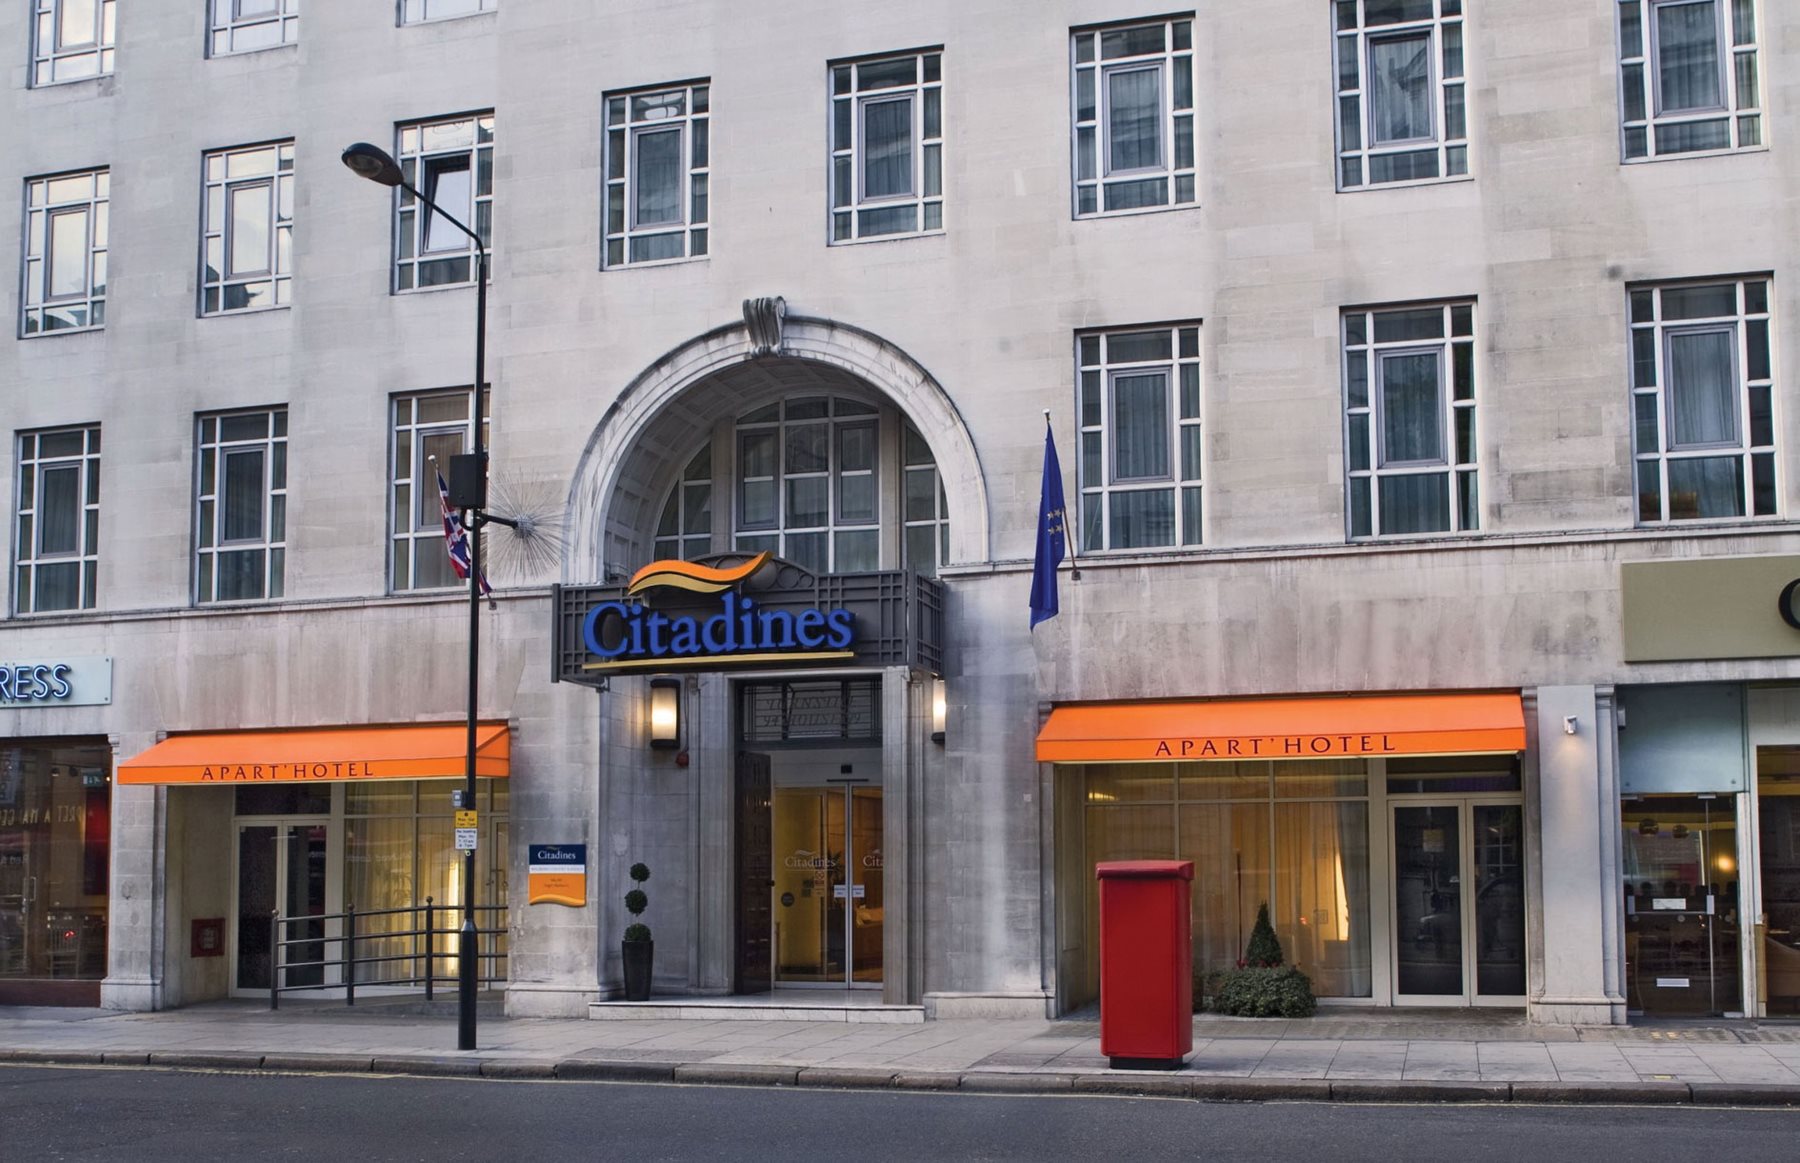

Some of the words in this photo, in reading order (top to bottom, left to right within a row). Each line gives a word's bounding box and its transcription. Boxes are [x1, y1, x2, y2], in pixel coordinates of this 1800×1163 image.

[583, 591, 856, 658] Citadines
[0, 664, 72, 701] RESS
[1155, 734, 1395, 757] APART'HOTEL
[202, 762, 374, 781] APART'HOTEL
[537, 849, 576, 860] Citadines
[784, 856, 837, 868] Citadines
